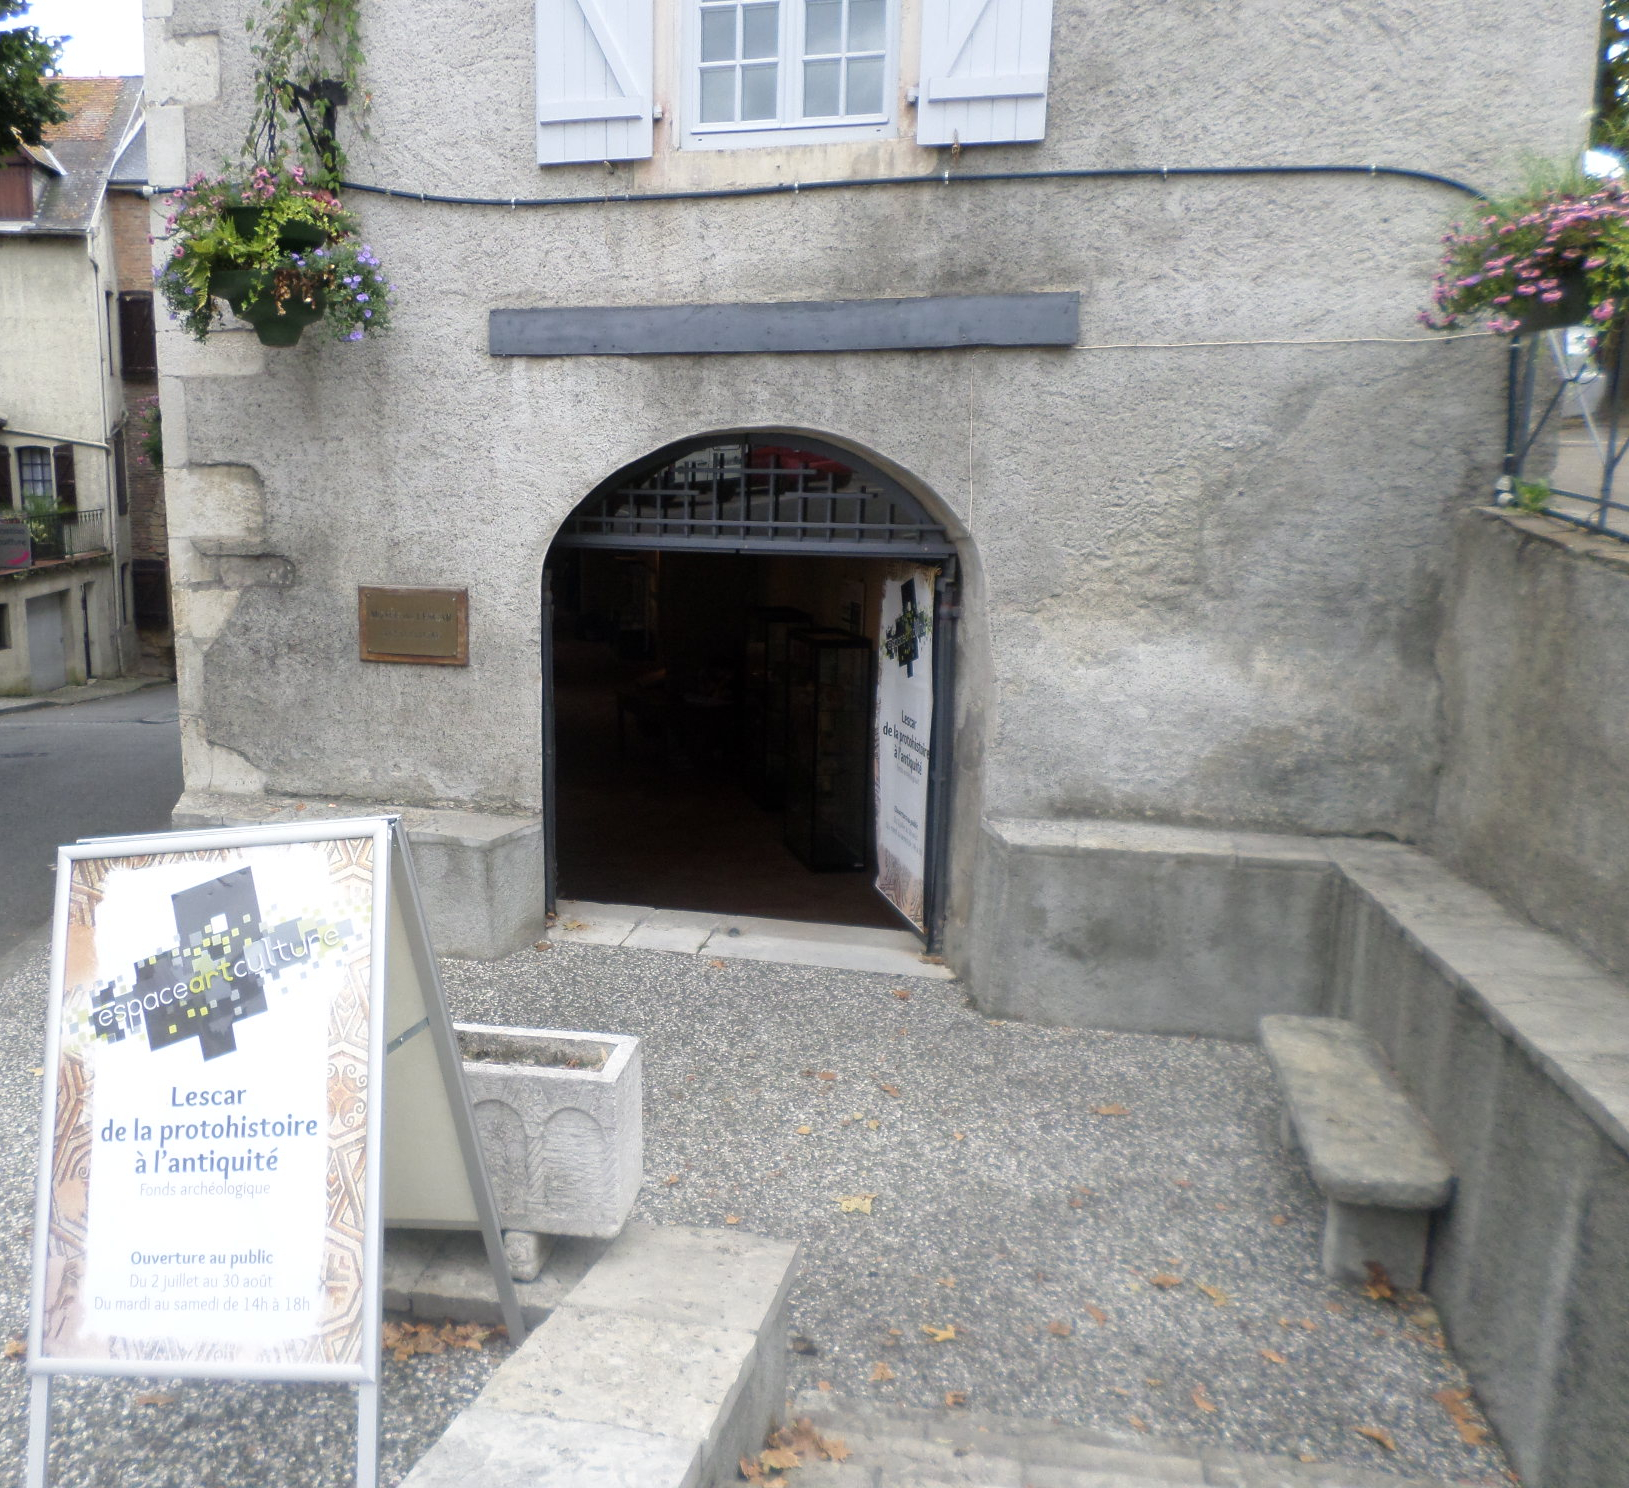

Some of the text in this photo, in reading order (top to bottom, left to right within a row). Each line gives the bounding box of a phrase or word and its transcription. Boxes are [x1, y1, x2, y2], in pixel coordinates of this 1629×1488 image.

[901, 709, 918, 730] Lescar
[882, 721, 893, 737] de
[893, 724, 899, 739] la
[171, 1086, 247, 1108] Lescar
[100, 1113, 319, 1149] de la protohistoire
[134, 1146, 280, 1180] à l'antiquité
[139, 1180, 271, 1200] Fonds archéologique
[130, 1249, 274, 1269] Ouverture au public
[128, 1272, 274, 1292] Du 2 juillet au 30 août
[93, 1296, 311, 1312] Du mardi au samedi de 14h à 18h
